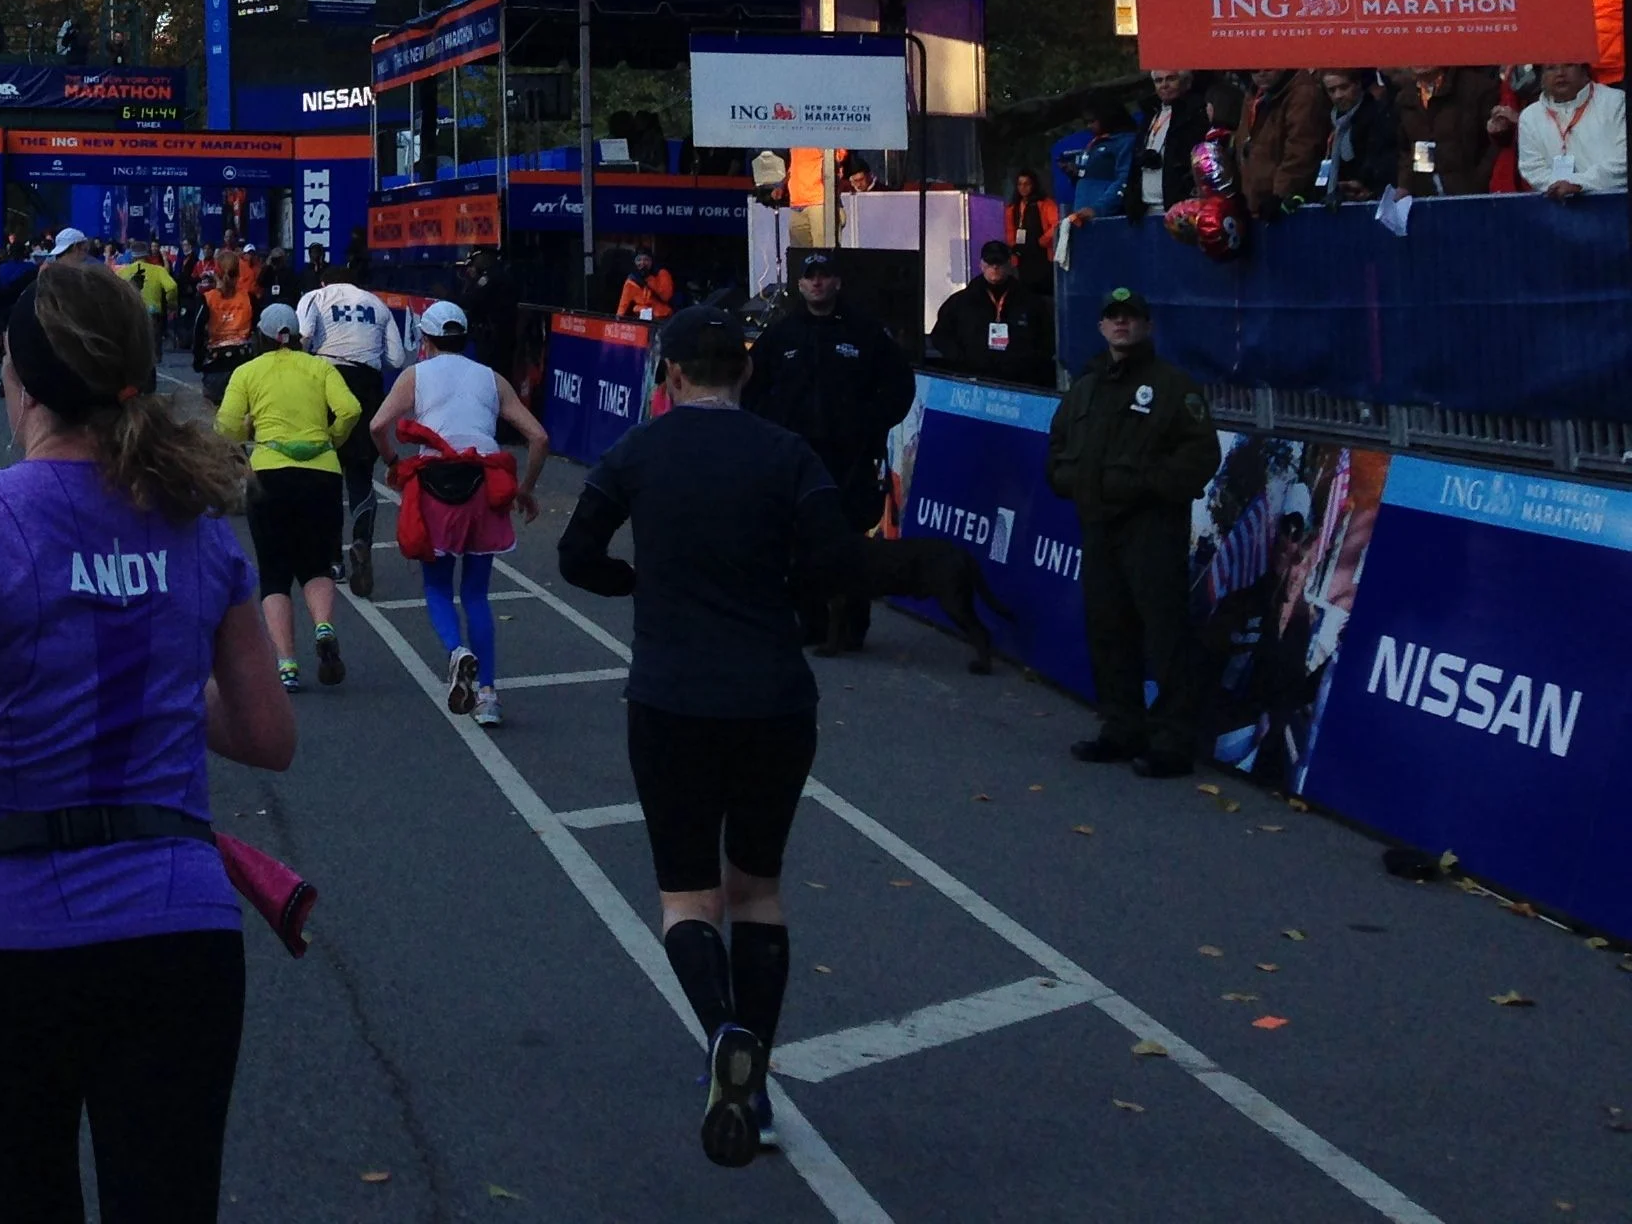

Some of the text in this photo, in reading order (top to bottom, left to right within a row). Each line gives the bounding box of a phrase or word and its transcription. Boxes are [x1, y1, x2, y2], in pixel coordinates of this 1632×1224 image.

[1211, 23, 1519, 38] PREMIER EVENT OF NEW YORK ROAD RUNNERS
[64, 84, 172, 100] MARATHON
[83, 75, 100, 84] ING
[302, 87, 375, 112] NISSAN
[730, 104, 769, 121] ING
[803, 112, 872, 123] MARATHON
[19, 136, 282, 151] THE ING NEW YORK CITY MARATHON
[112, 166, 134, 176] ING
[612, 203, 748, 218] THE ING NEW YORK CI
[553, 368, 583, 405] TIMEX
[597, 378, 631, 418] TIMEX
[1439, 474, 1485, 511] ING
[916, 496, 990, 545] UNITED
[1521, 501, 1605, 534] MARATHON
[1033, 534, 1083, 581] UNIT
[70, 549, 169, 597] ANDY
[1366, 634, 1584, 758] NISSAN
